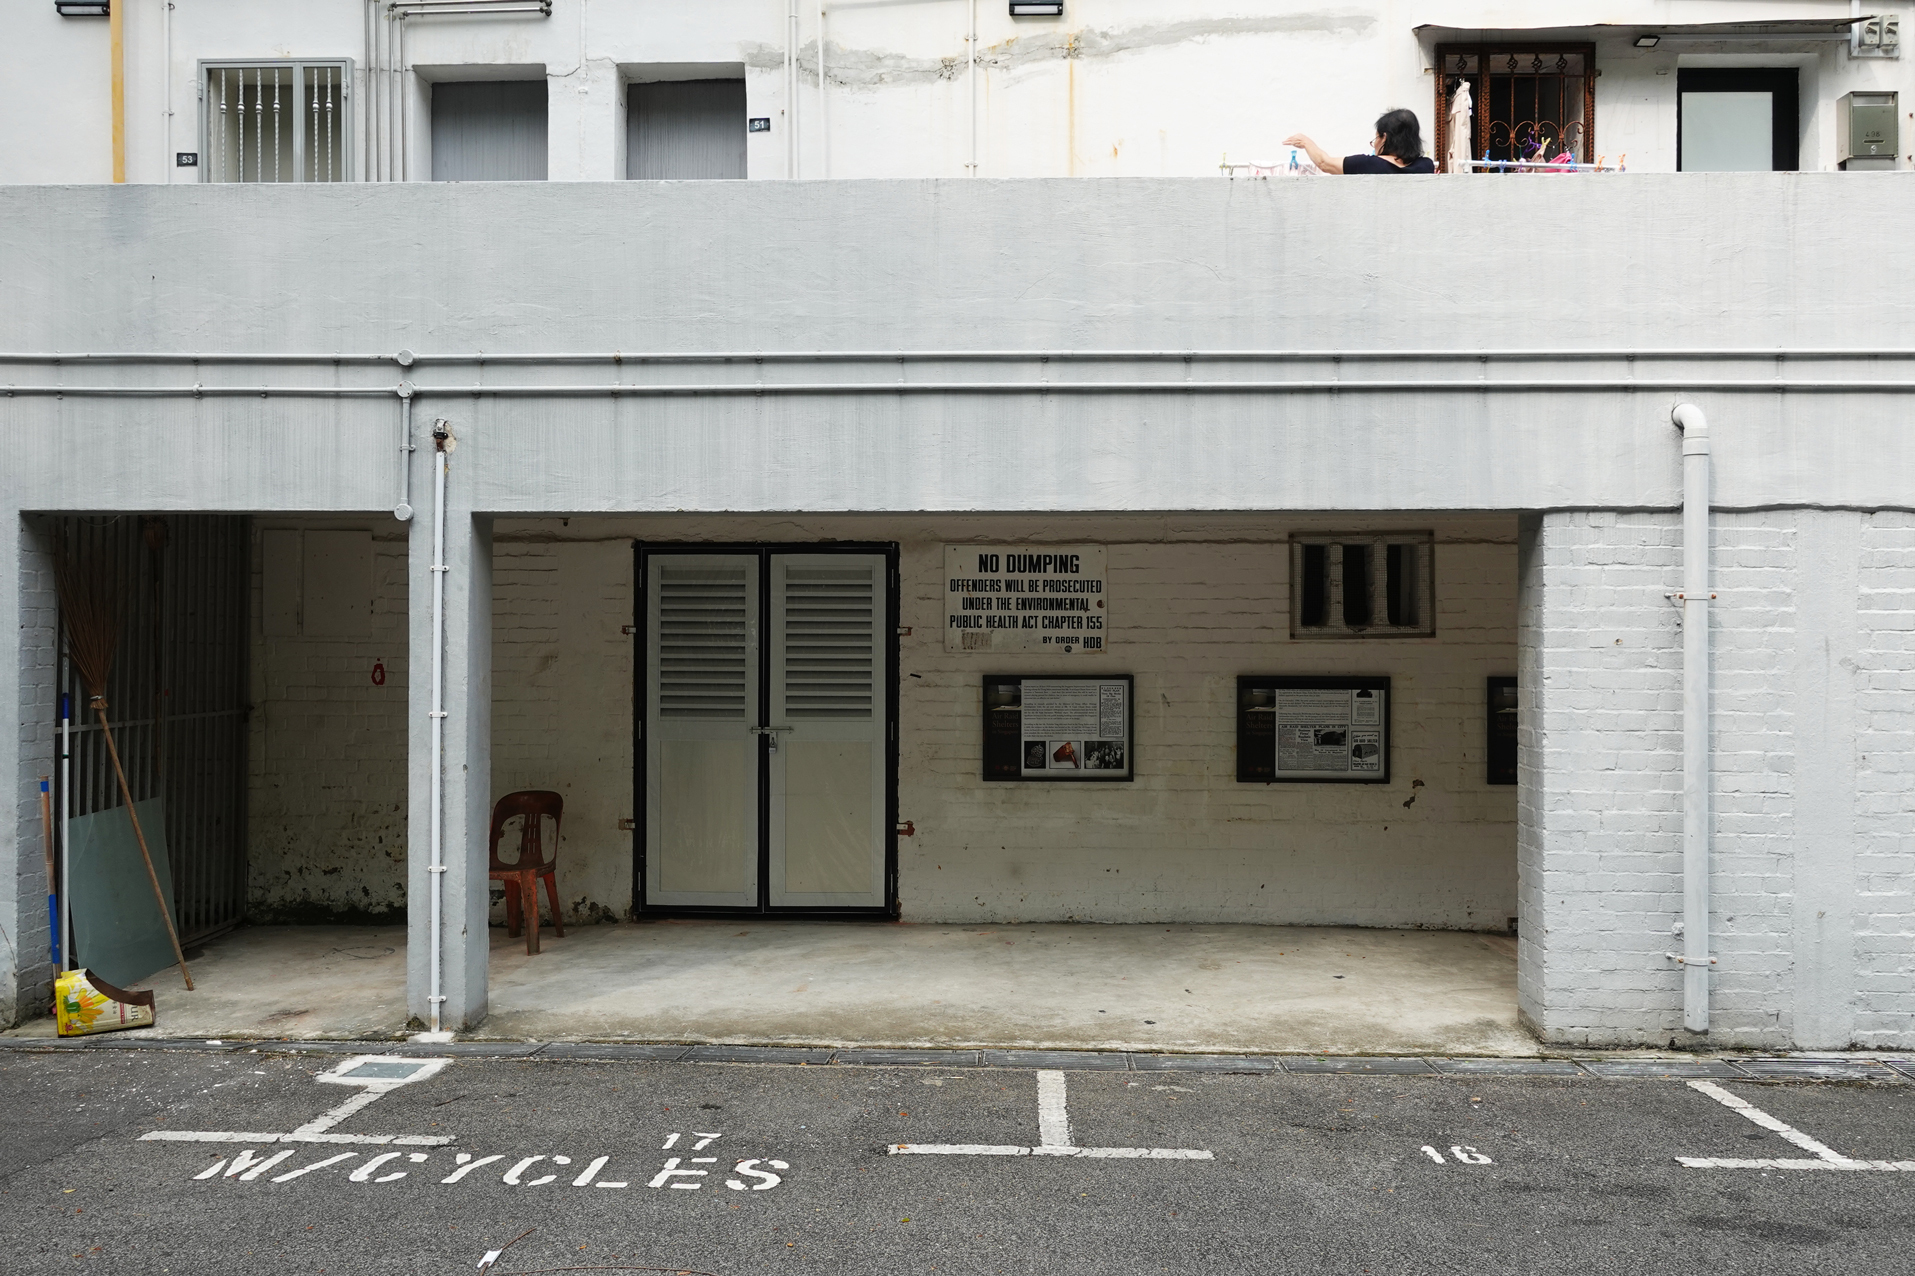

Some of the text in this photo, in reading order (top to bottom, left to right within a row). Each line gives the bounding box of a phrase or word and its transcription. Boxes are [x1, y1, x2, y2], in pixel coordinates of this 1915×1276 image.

[754, 120, 764, 129] 51
[182, 155, 193, 164] 53
[978, 554, 1080, 574] NO DUMPING
[950, 579, 1102, 594] OFFENDERS WILL BE PROSECUTED
[962, 597, 1090, 612] UNDER THE ENVIRONMENTAL
[950, 615, 1103, 630] PUBLIC HEALTH ACT CHAPTER 155
[1042, 636, 1102, 649] BY ORDER HDB
[992, 720, 1019, 728] Shelters
[1246, 721, 1273, 729] Shelters
[661, 1132, 722, 1151] 17
[1420, 1145, 1493, 1165] 16
[192, 1149, 790, 1191] M/CYCLES
